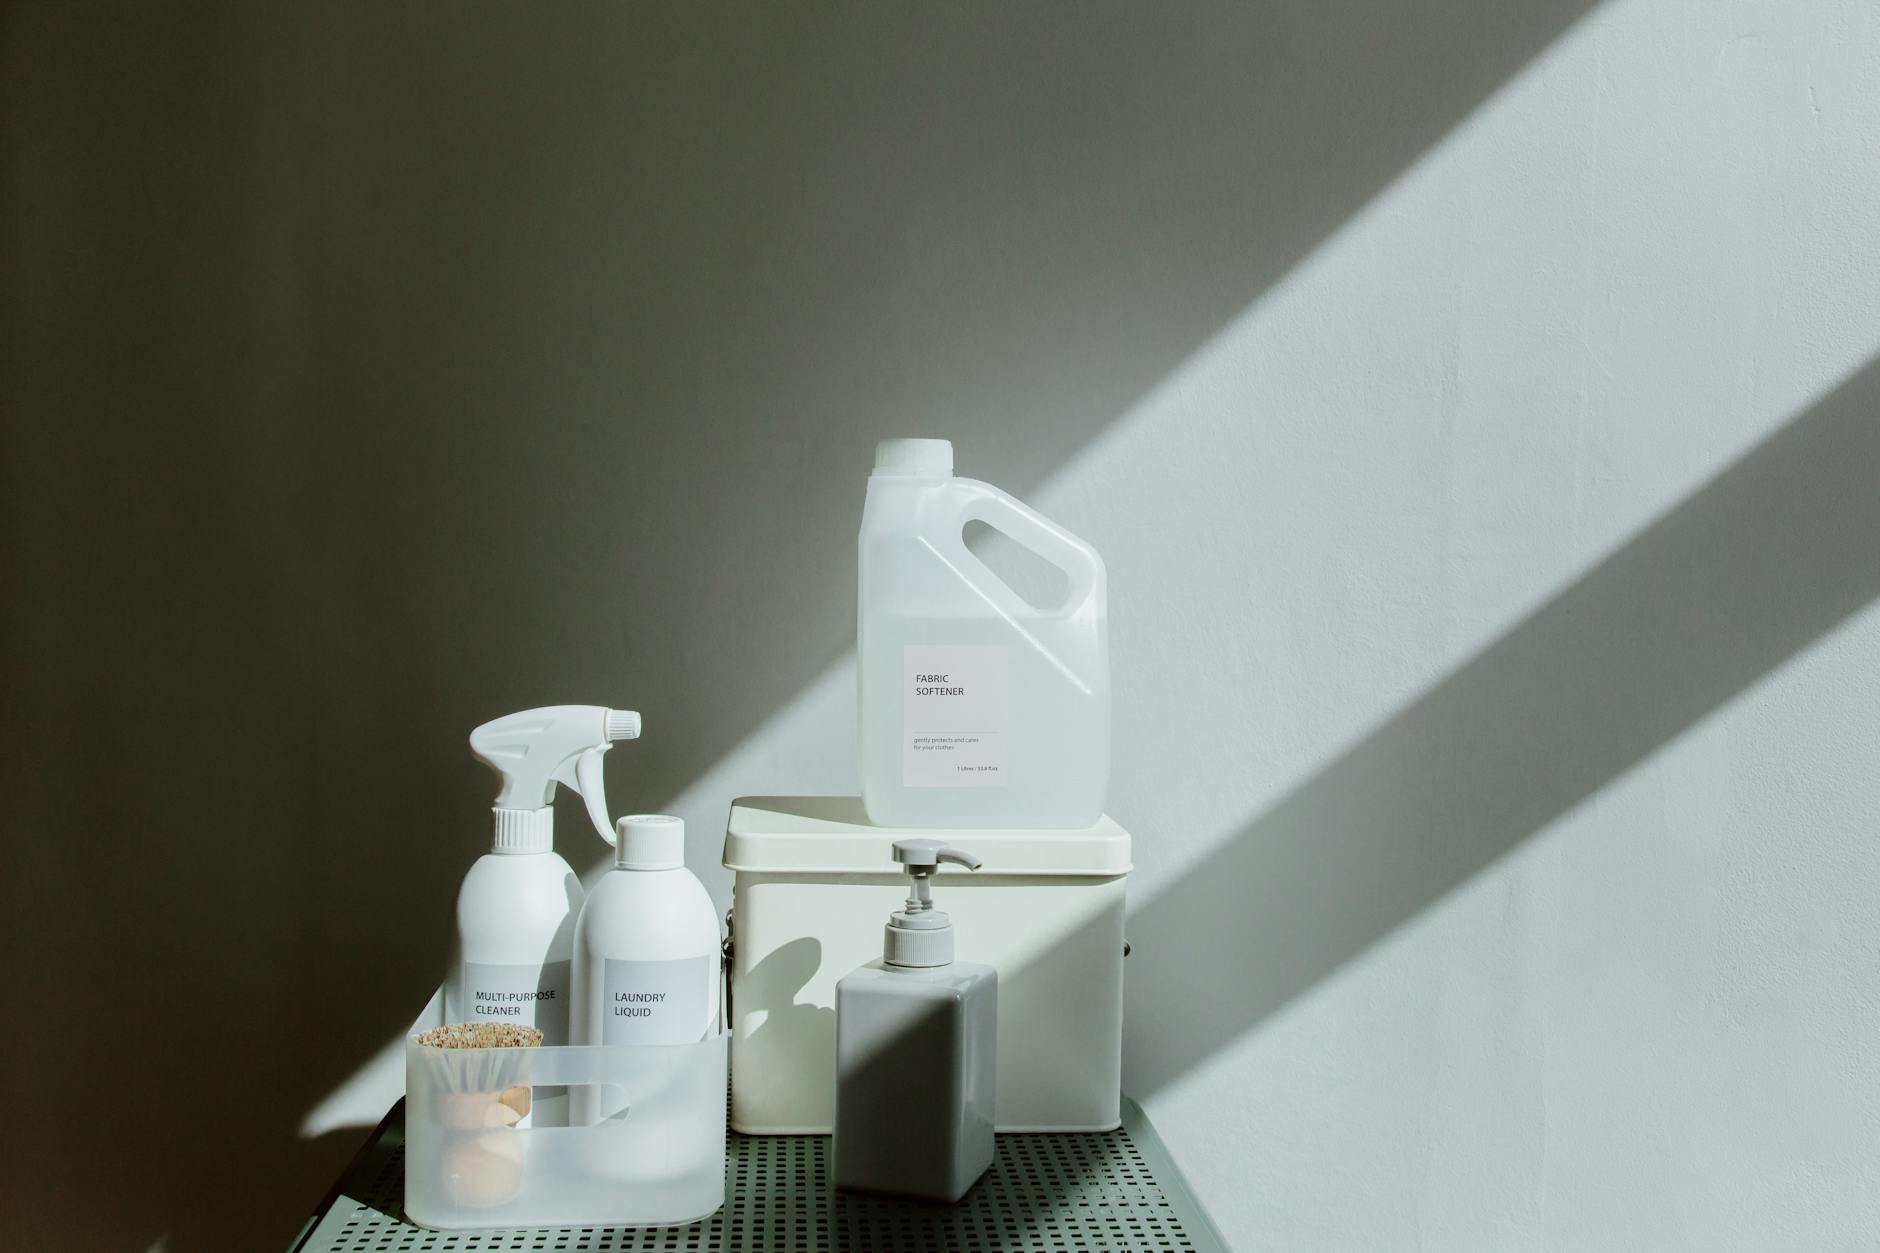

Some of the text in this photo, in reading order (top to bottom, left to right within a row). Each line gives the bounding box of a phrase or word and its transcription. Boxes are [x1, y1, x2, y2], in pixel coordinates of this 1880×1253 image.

[916, 674, 949, 683] FABRIC
[916, 687, 964, 696] SOFTENER
[475, 990, 556, 1002] MULTI-PURPOSE
[615, 992, 666, 1003] LAUNDRY
[475, 1005, 521, 1016] CLEANER
[615, 1006, 652, 1018] LIQUID
